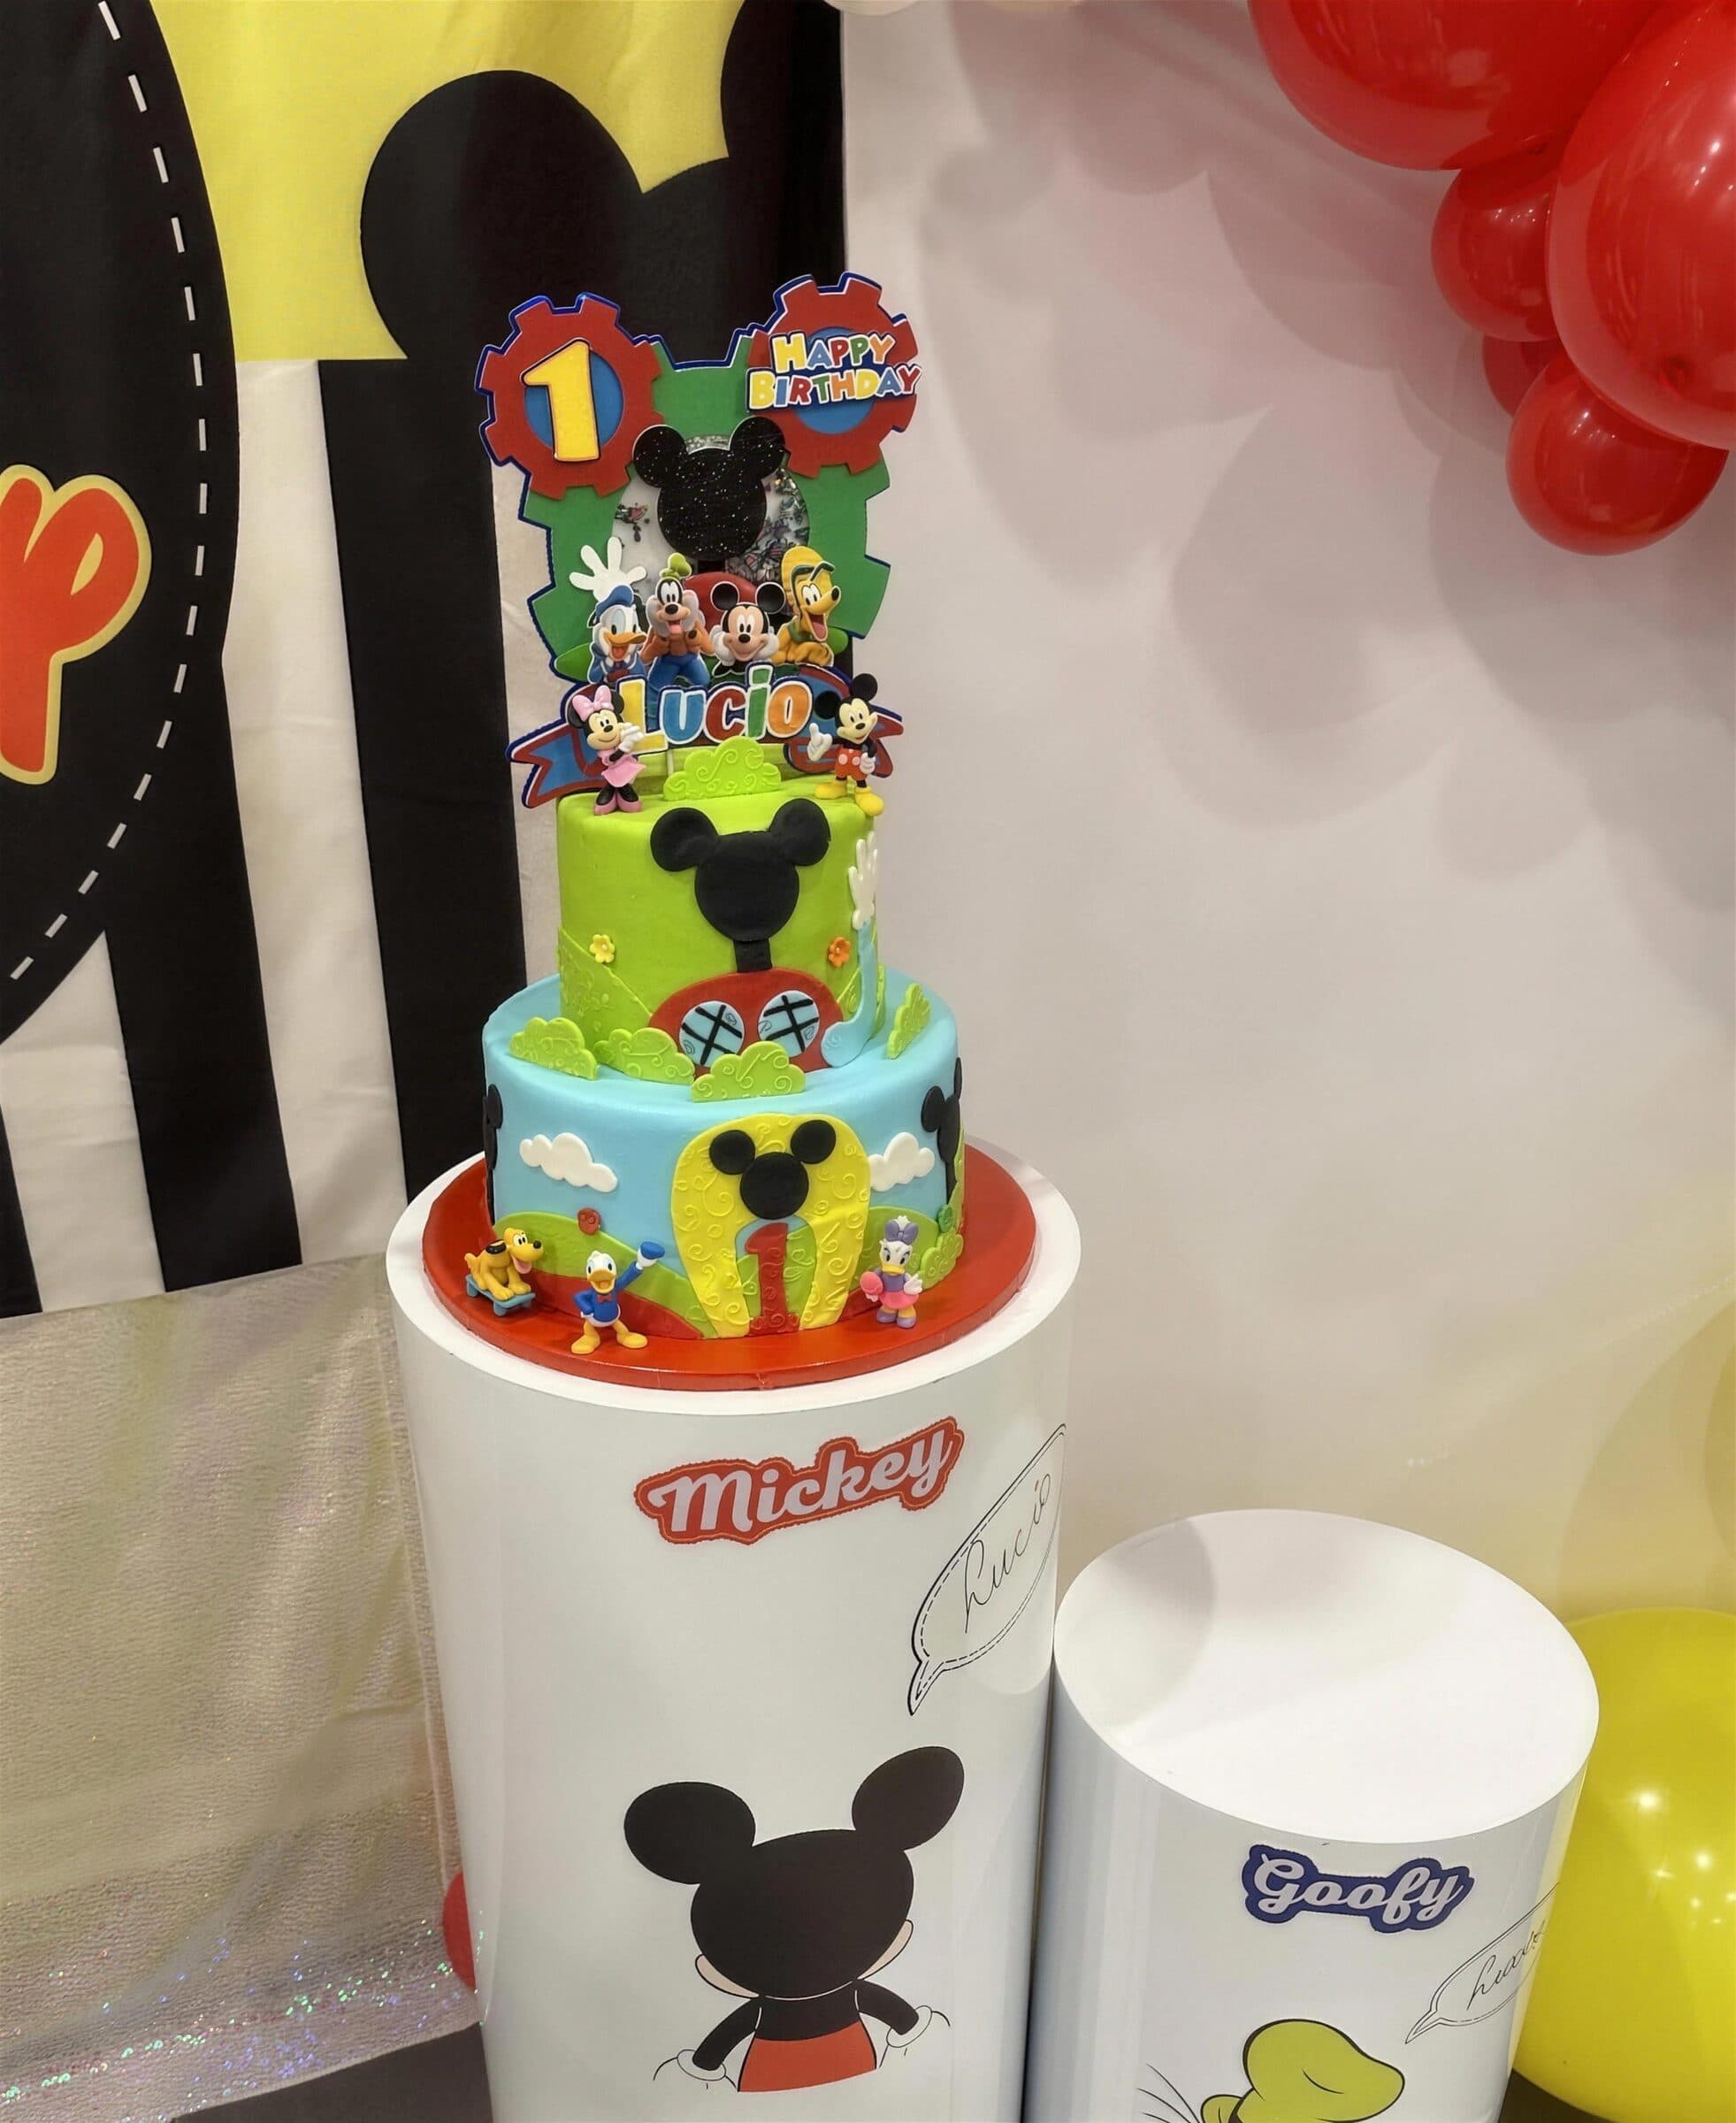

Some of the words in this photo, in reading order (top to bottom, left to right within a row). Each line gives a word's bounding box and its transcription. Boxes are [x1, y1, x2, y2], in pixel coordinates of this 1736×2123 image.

[749, 364, 922, 410] BIRTHDAY
[772, 333, 896, 373] HAPPY
[522, 338, 600, 462] 1
[745, 1222, 801, 1337] 1
[646, 1428, 953, 1534] Mickey
[1253, 1852, 1464, 1926] Goofy
